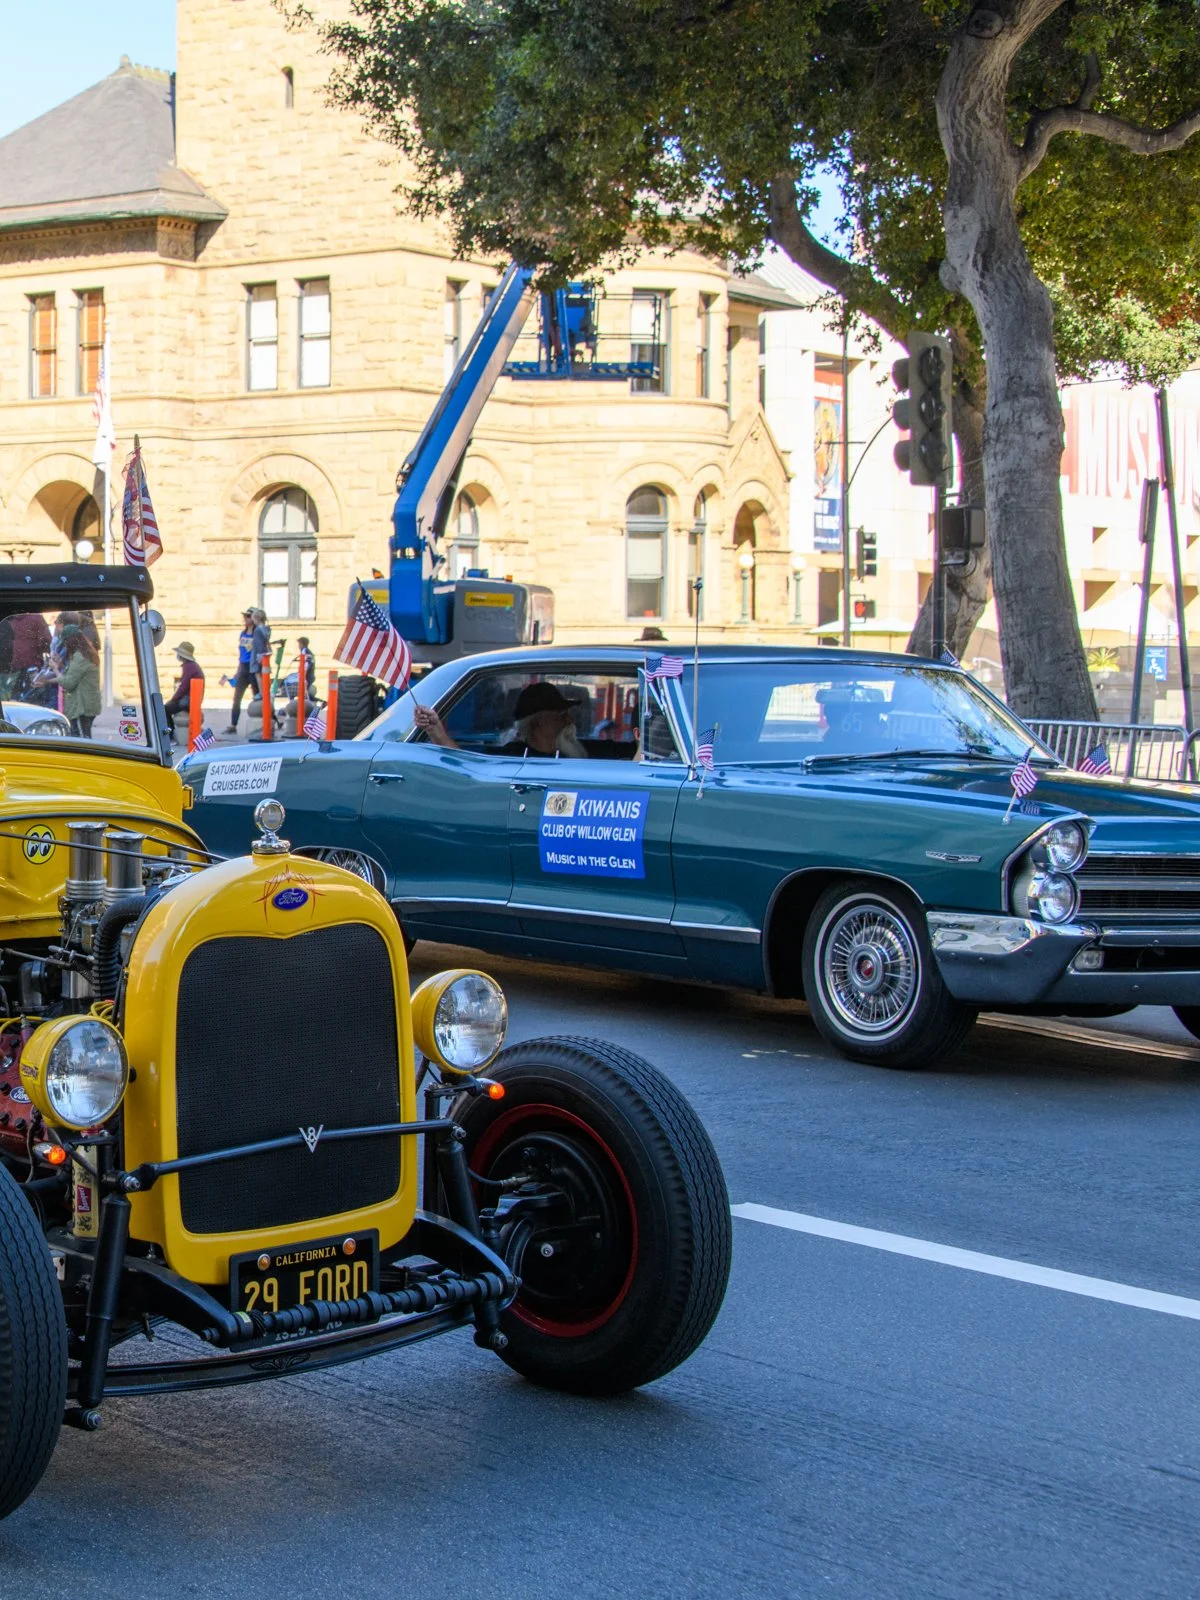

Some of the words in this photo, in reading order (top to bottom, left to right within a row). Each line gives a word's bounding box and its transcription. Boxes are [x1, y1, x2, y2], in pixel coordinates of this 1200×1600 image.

[841, 713, 862, 732] 65
[210, 763, 250, 776] SATURDAY
[251, 761, 279, 774] NIGHT
[211, 778, 270, 792] CRUISERS.COM
[577, 799, 642, 819] KIWANIS
[542, 823, 564, 838] CLUB
[565, 825, 577, 838] OF
[577, 825, 612, 841] WILLOW
[612, 827, 637, 842] GLEN
[546, 851, 576, 865] MUSIC
[577, 855, 587, 866] IN
[588, 856, 608, 868] THE
[608, 856, 637, 869] GLEN
[278, 889, 305, 905] Ford
[275, 1246, 337, 1267] CALIFORNIA
[244, 1277, 279, 1315] 29
[299, 1260, 368, 1306] FORD
